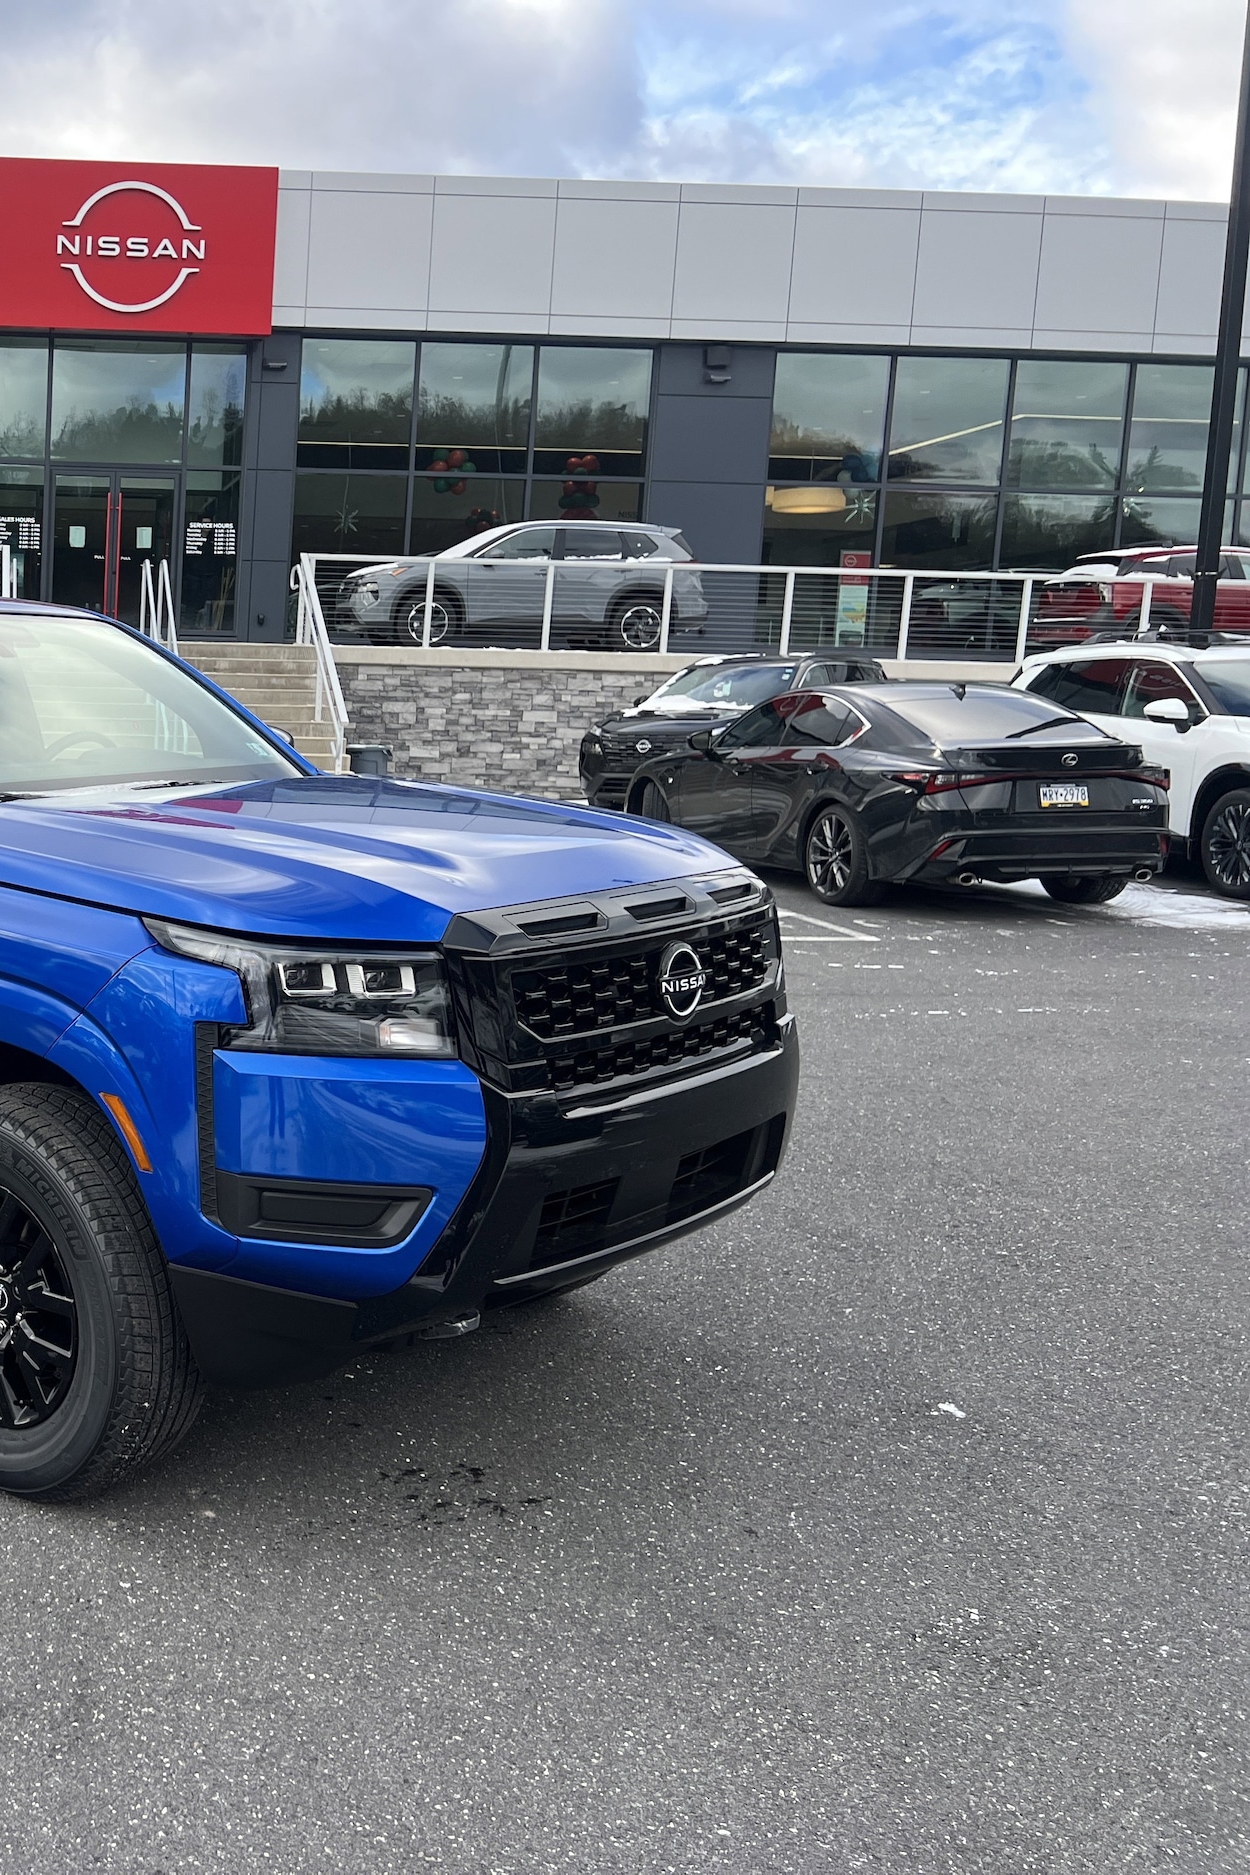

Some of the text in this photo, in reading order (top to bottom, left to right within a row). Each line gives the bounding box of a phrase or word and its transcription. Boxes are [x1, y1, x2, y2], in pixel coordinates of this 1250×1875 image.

[57, 234, 206, 260] NISSAN
[661, 974, 706, 993] NISSAN
[14, 1158, 87, 1256] MICHELIN
